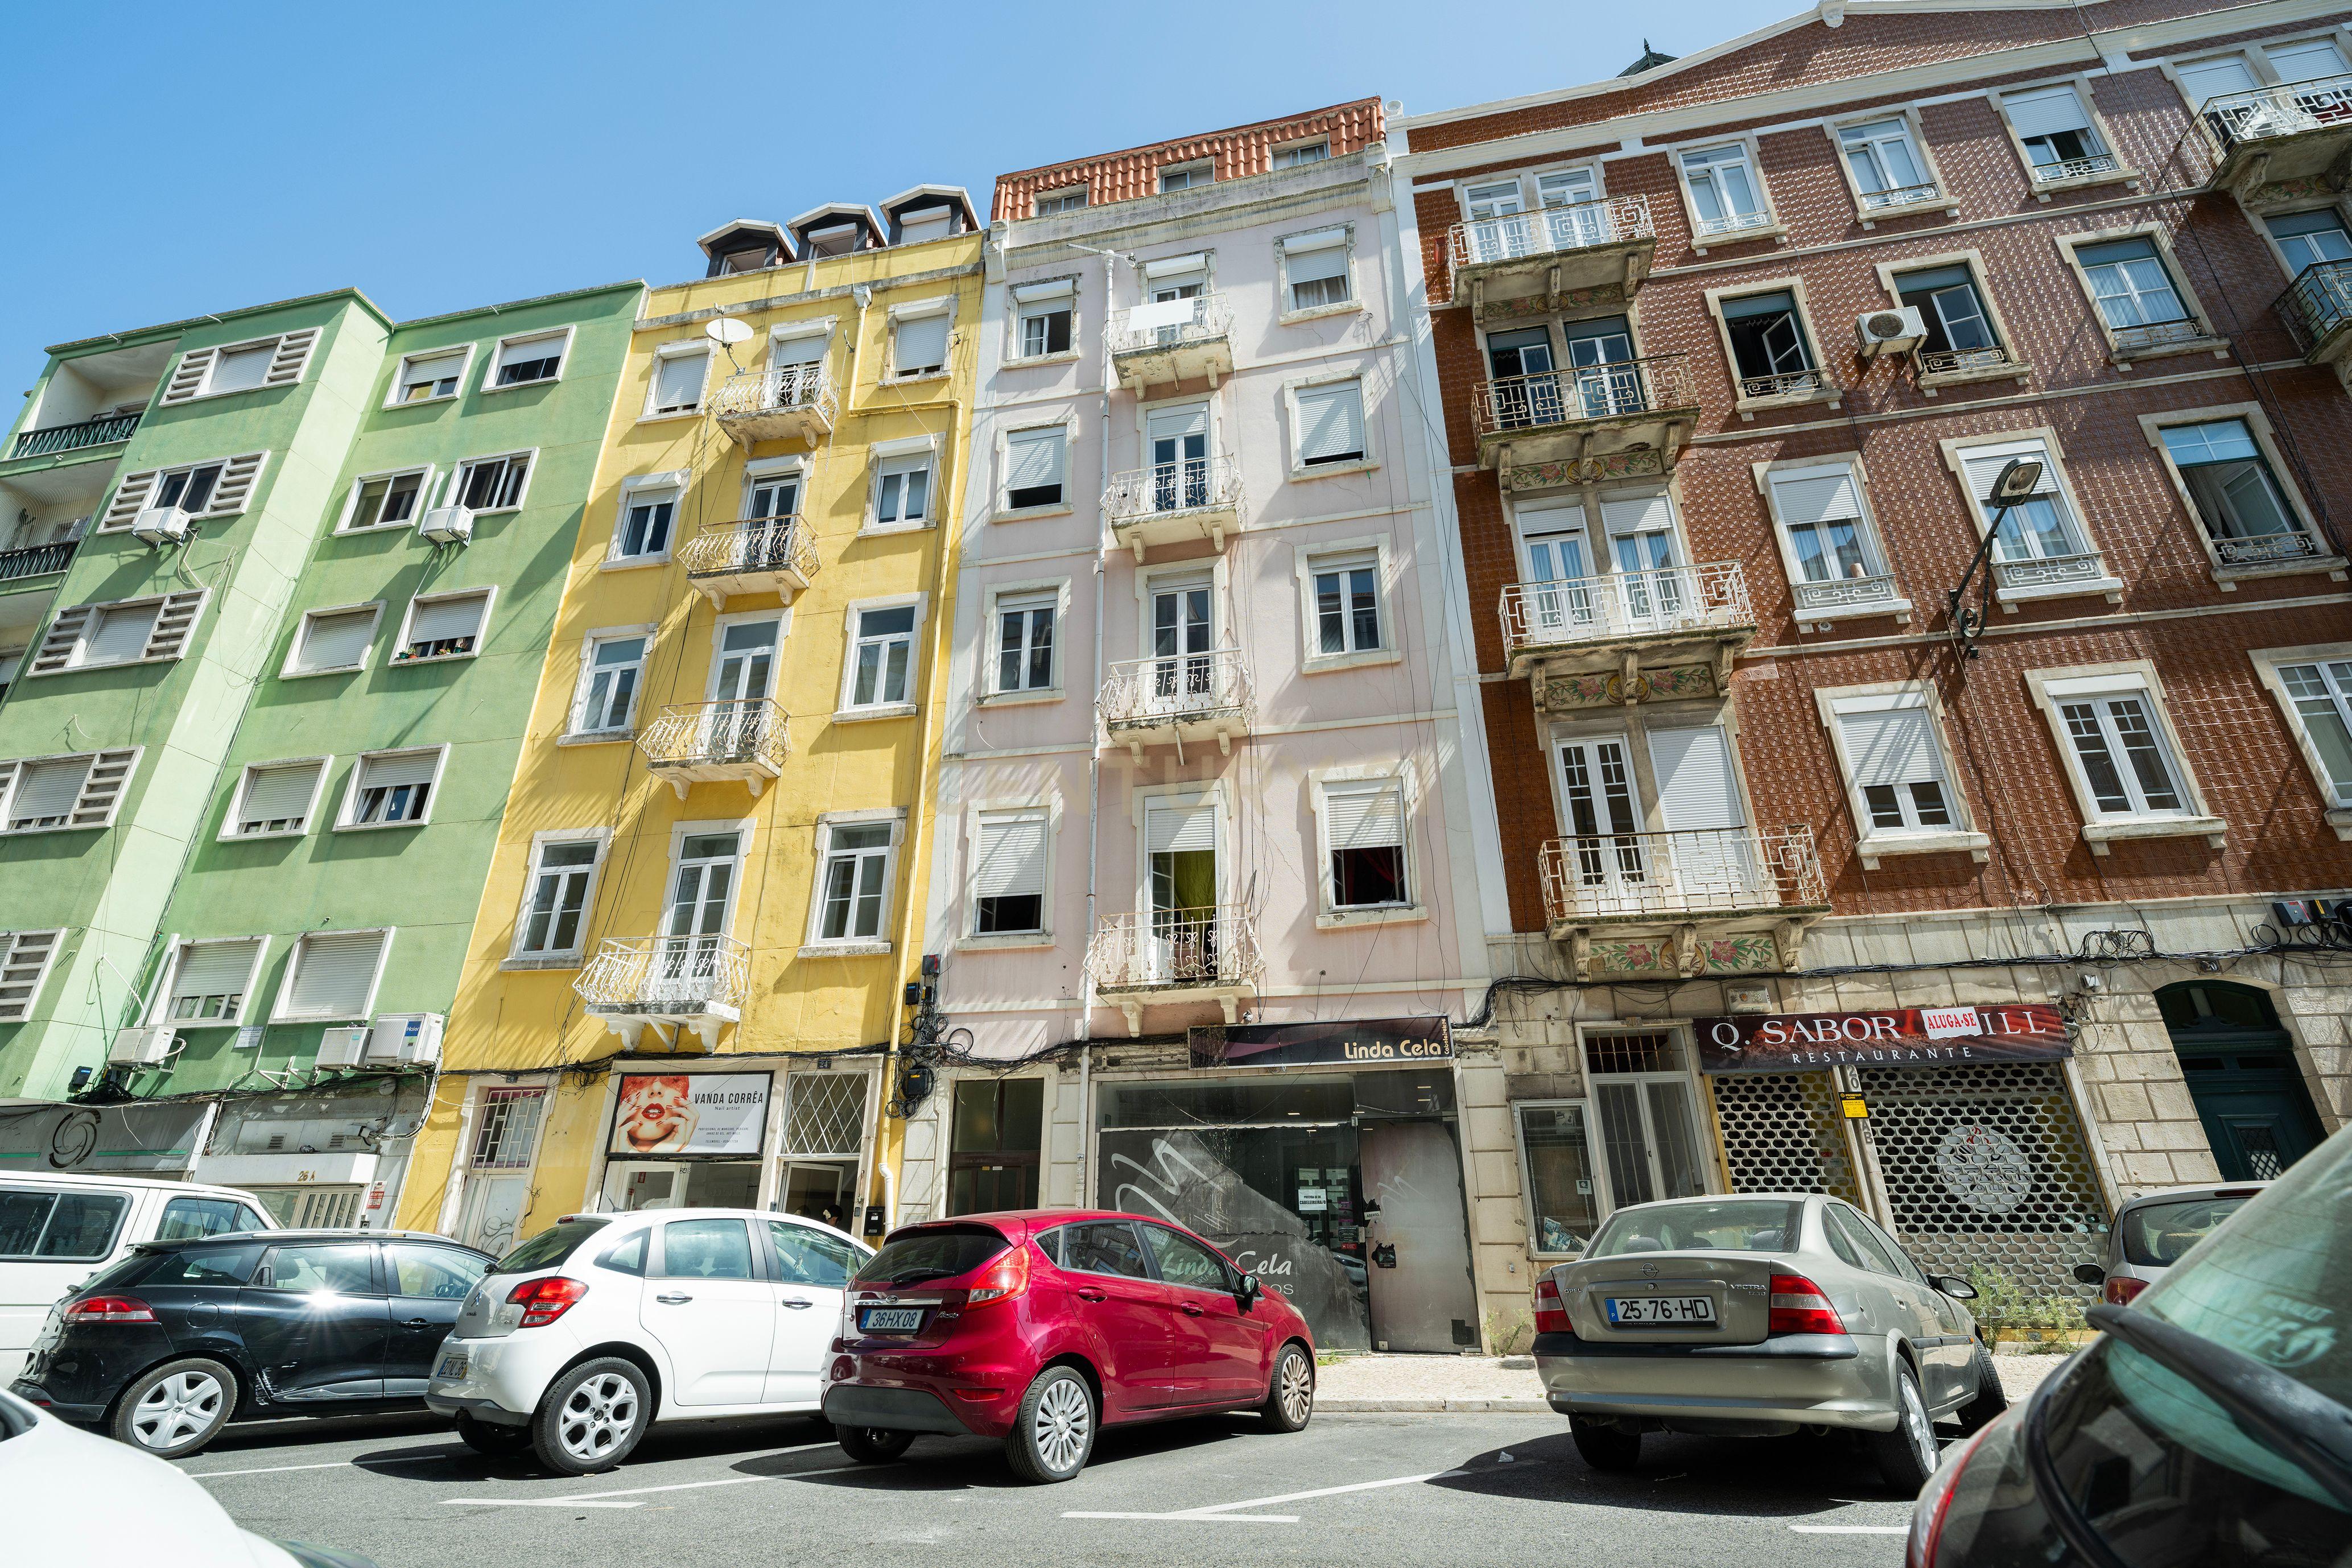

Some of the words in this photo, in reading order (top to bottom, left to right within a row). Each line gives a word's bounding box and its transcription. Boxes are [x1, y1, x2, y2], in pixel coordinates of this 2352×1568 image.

[1926, 1012, 1977, 1029] ALUGA-SE
[1441, 1018, 1450, 1055] Cabeleireiros
[1711, 1023, 1751, 1051] Q.
[1763, 1016, 1902, 1045] SABOR
[1980, 1011, 2046, 1035] ILL
[1344, 1041, 1394, 1059] Linda
[1400, 1038, 1441, 1057] Cela
[1792, 1047, 1971, 1063] RESTAURANTE
[695, 1093, 724, 1104] VANDA
[728, 1091, 763, 1104] CORRÊA
[297, 1170, 310, 1182] 26
[310, 1170, 316, 1181] A
[1161, 1251, 1222, 1276] Linda
[1235, 1251, 1292, 1276] Cela
